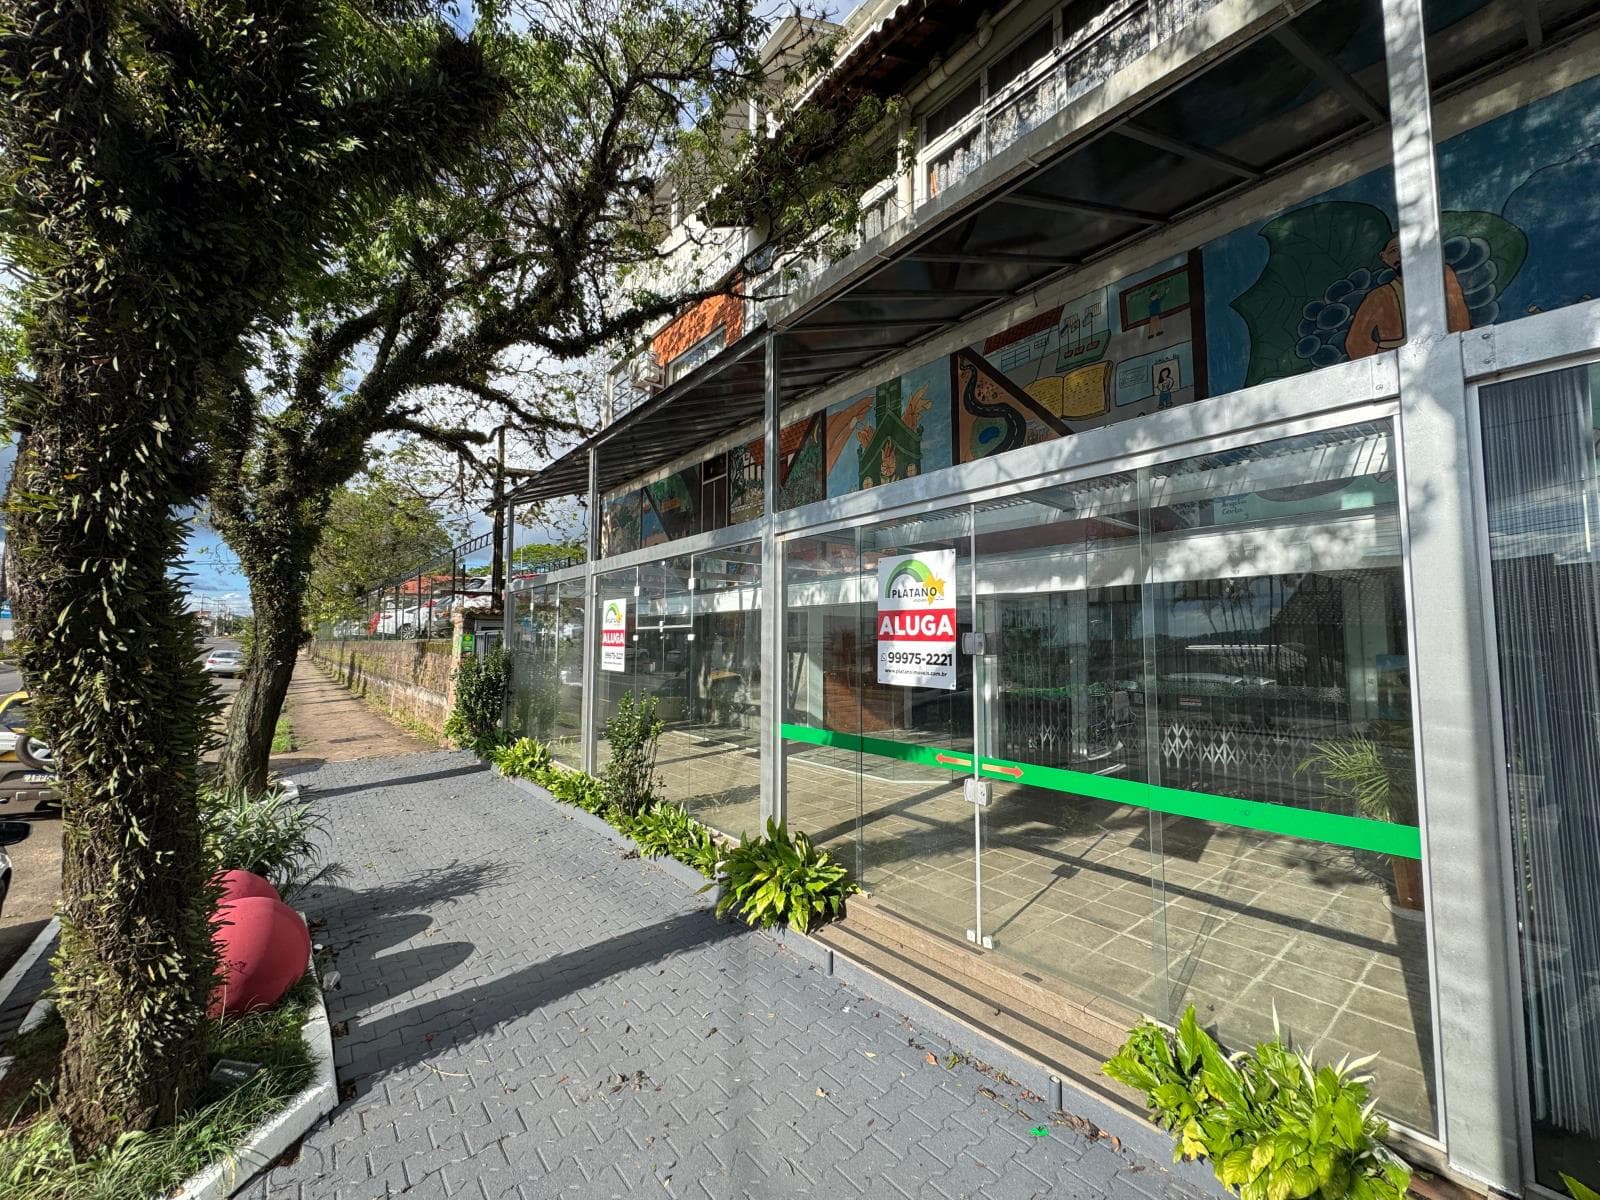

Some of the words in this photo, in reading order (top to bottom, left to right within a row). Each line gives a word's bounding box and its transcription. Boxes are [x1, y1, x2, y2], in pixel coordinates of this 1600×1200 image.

[892, 587, 937, 598] PLATANO
[879, 614, 954, 636] ALUGA
[888, 652, 952, 666] 99975-2221
